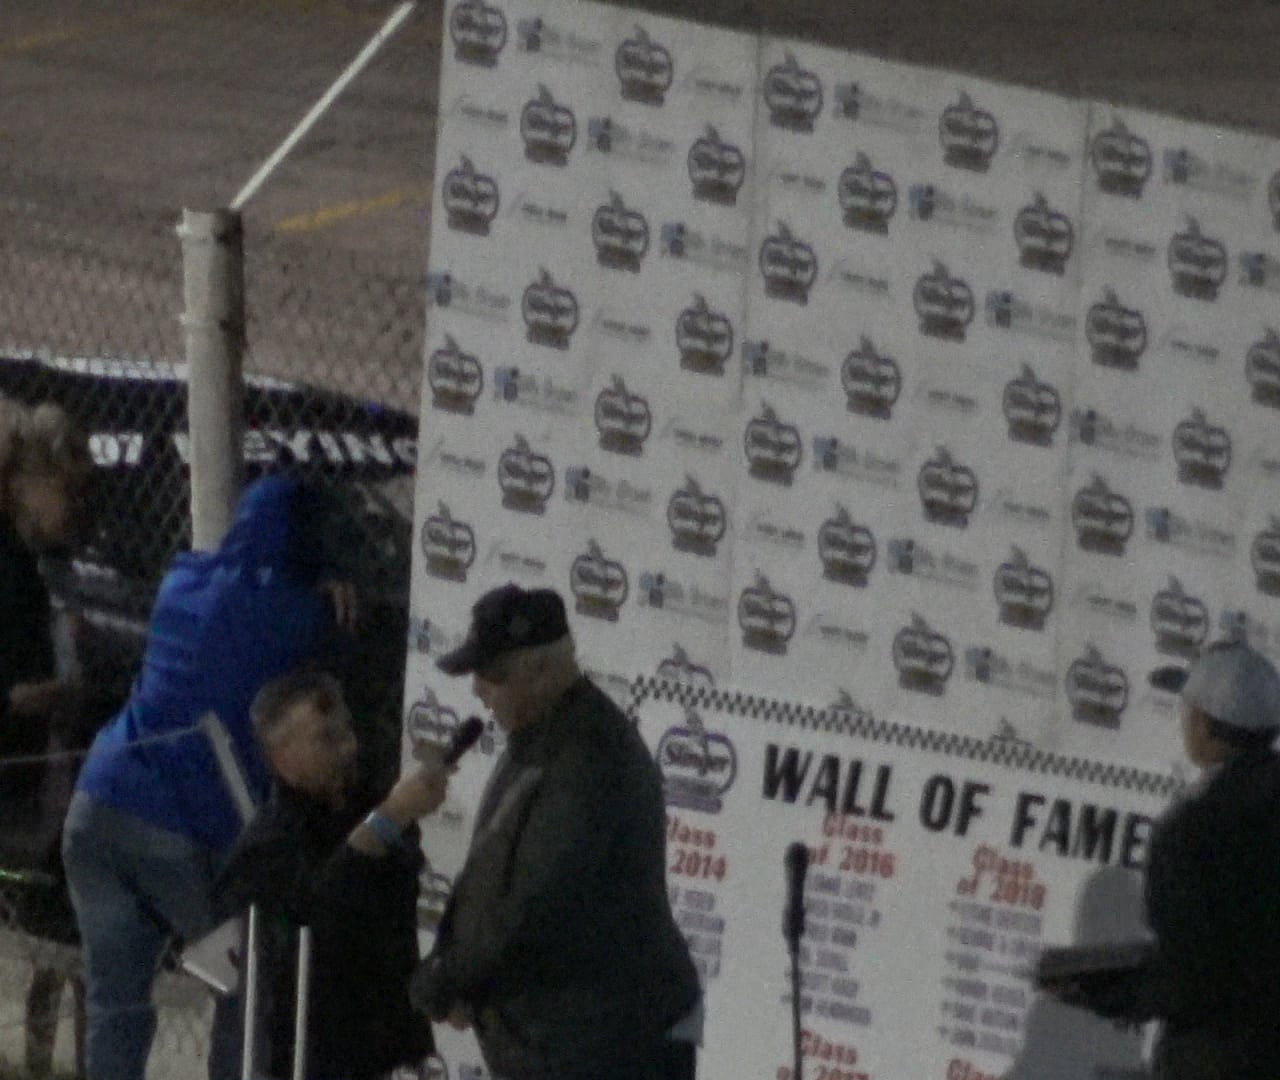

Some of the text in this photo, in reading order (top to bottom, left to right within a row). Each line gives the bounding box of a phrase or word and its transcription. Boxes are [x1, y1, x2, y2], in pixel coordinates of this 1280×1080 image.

[762, 743, 894, 821] WALL
[919, 773, 992, 837] OF
[1010, 792, 1156, 870] FAME
[666, 815, 717, 848] lass
[823, 814, 883, 844] Class
[670, 849, 728, 882] 2014
[839, 845, 897, 878] 2016
[973, 845, 1035, 881] Class
[957, 876, 978, 896] of
[799, 1028, 858, 1065] Class
